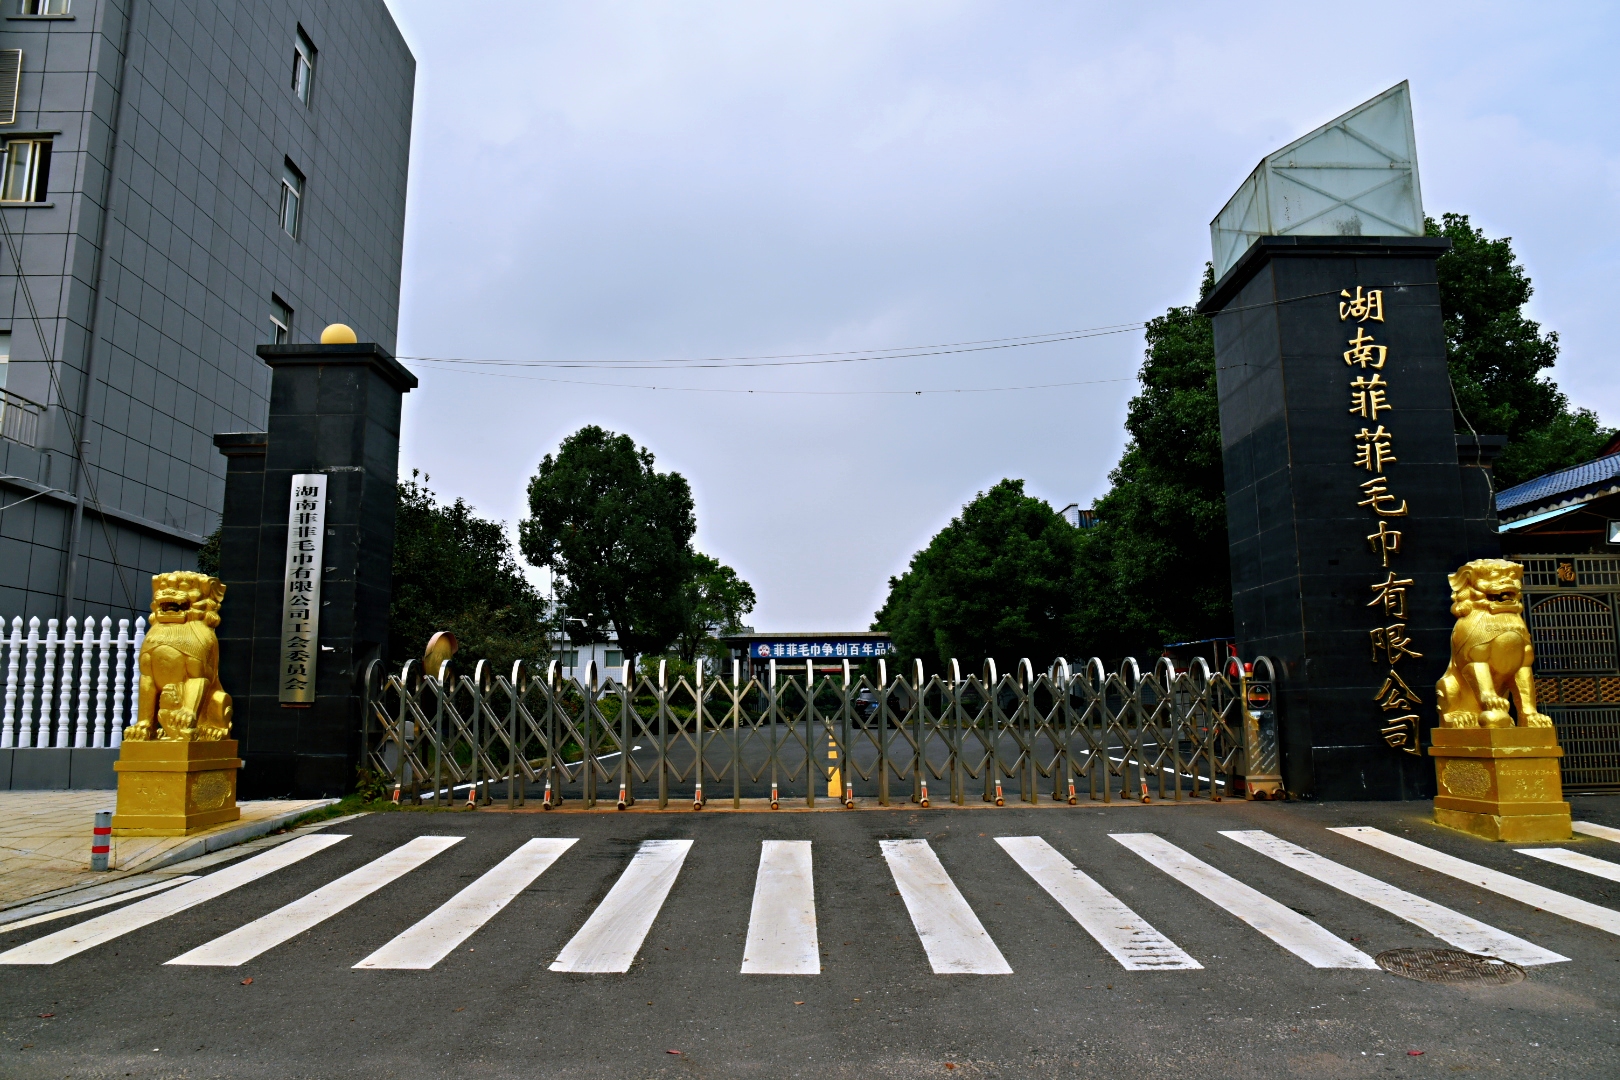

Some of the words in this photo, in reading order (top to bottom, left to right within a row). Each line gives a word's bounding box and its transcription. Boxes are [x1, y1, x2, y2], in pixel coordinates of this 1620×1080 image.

[285, 485, 320, 690] 湖南菲菲毛巾有限公司工会委员会
[1339, 286, 1423, 757] 湖南菲菲毛巾有限公司
